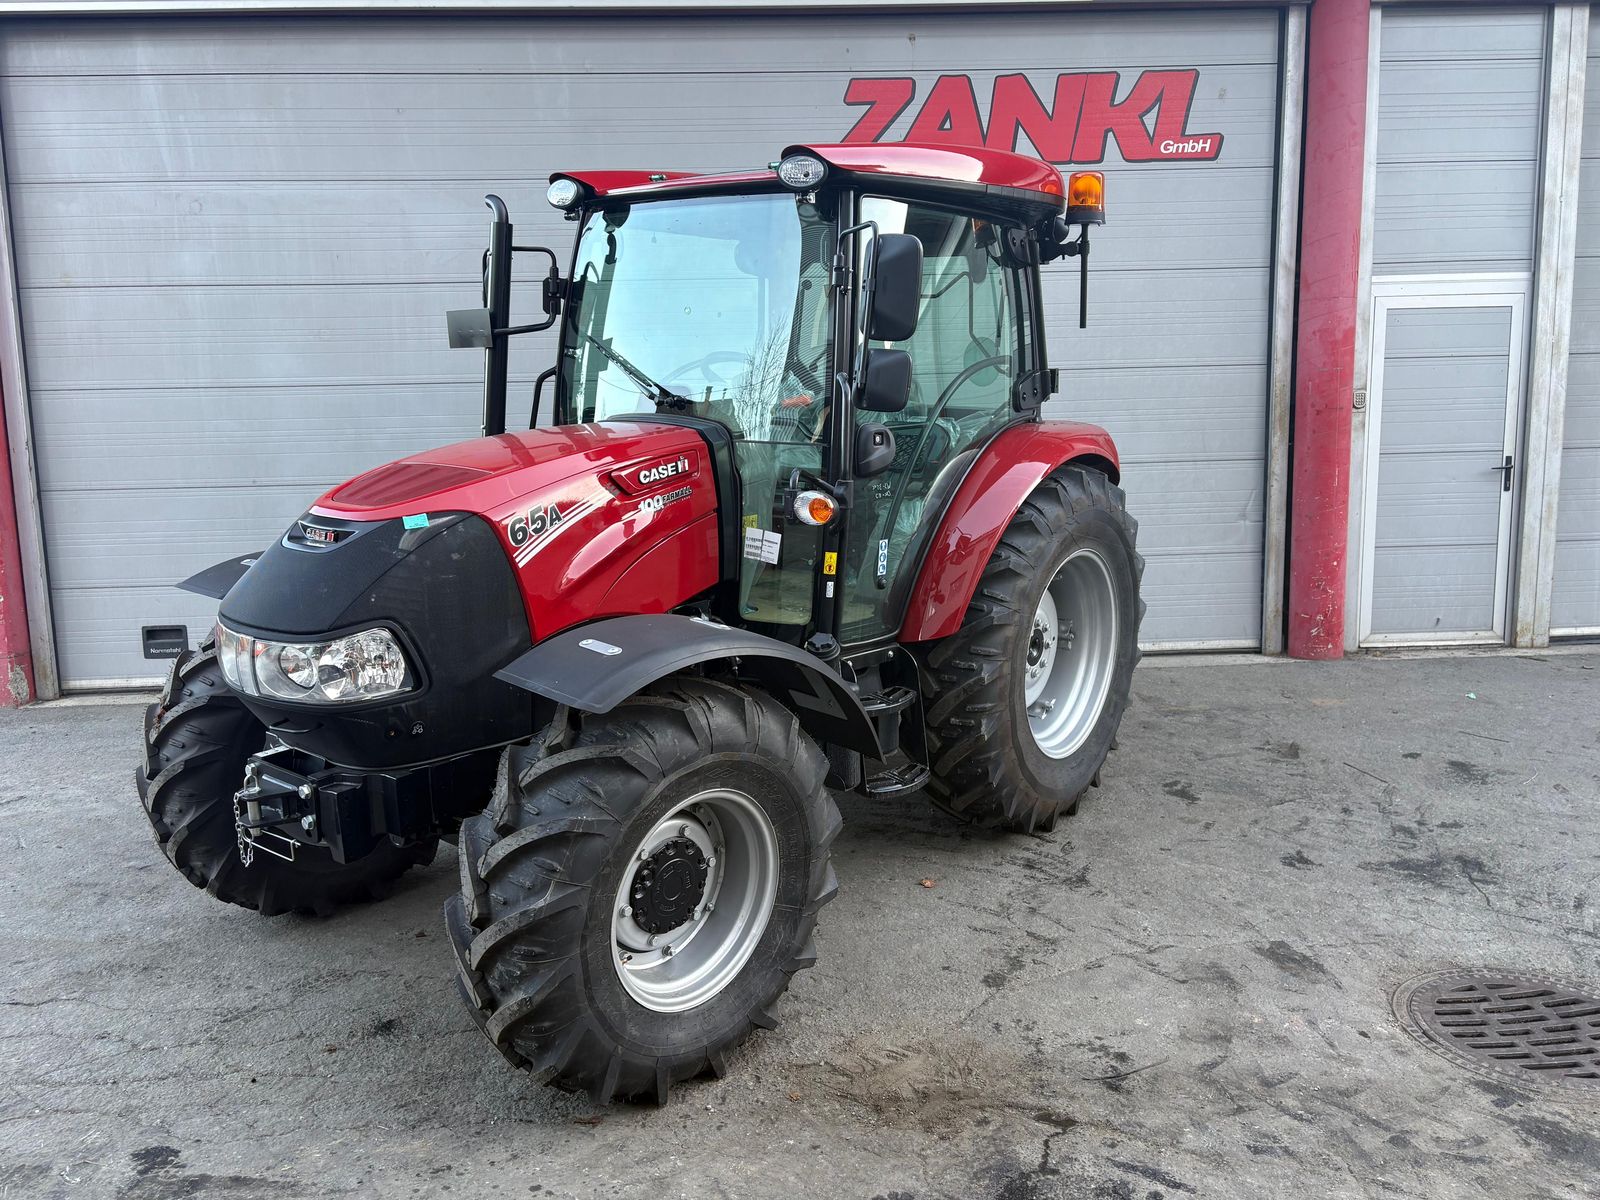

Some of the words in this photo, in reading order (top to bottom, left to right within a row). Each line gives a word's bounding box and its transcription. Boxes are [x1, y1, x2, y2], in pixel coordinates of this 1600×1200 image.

[840, 69, 1224, 165] ZANKL
[1160, 139, 1211, 153] GmbH
[639, 462, 677, 484] CASE
[508, 503, 564, 547] 65A
